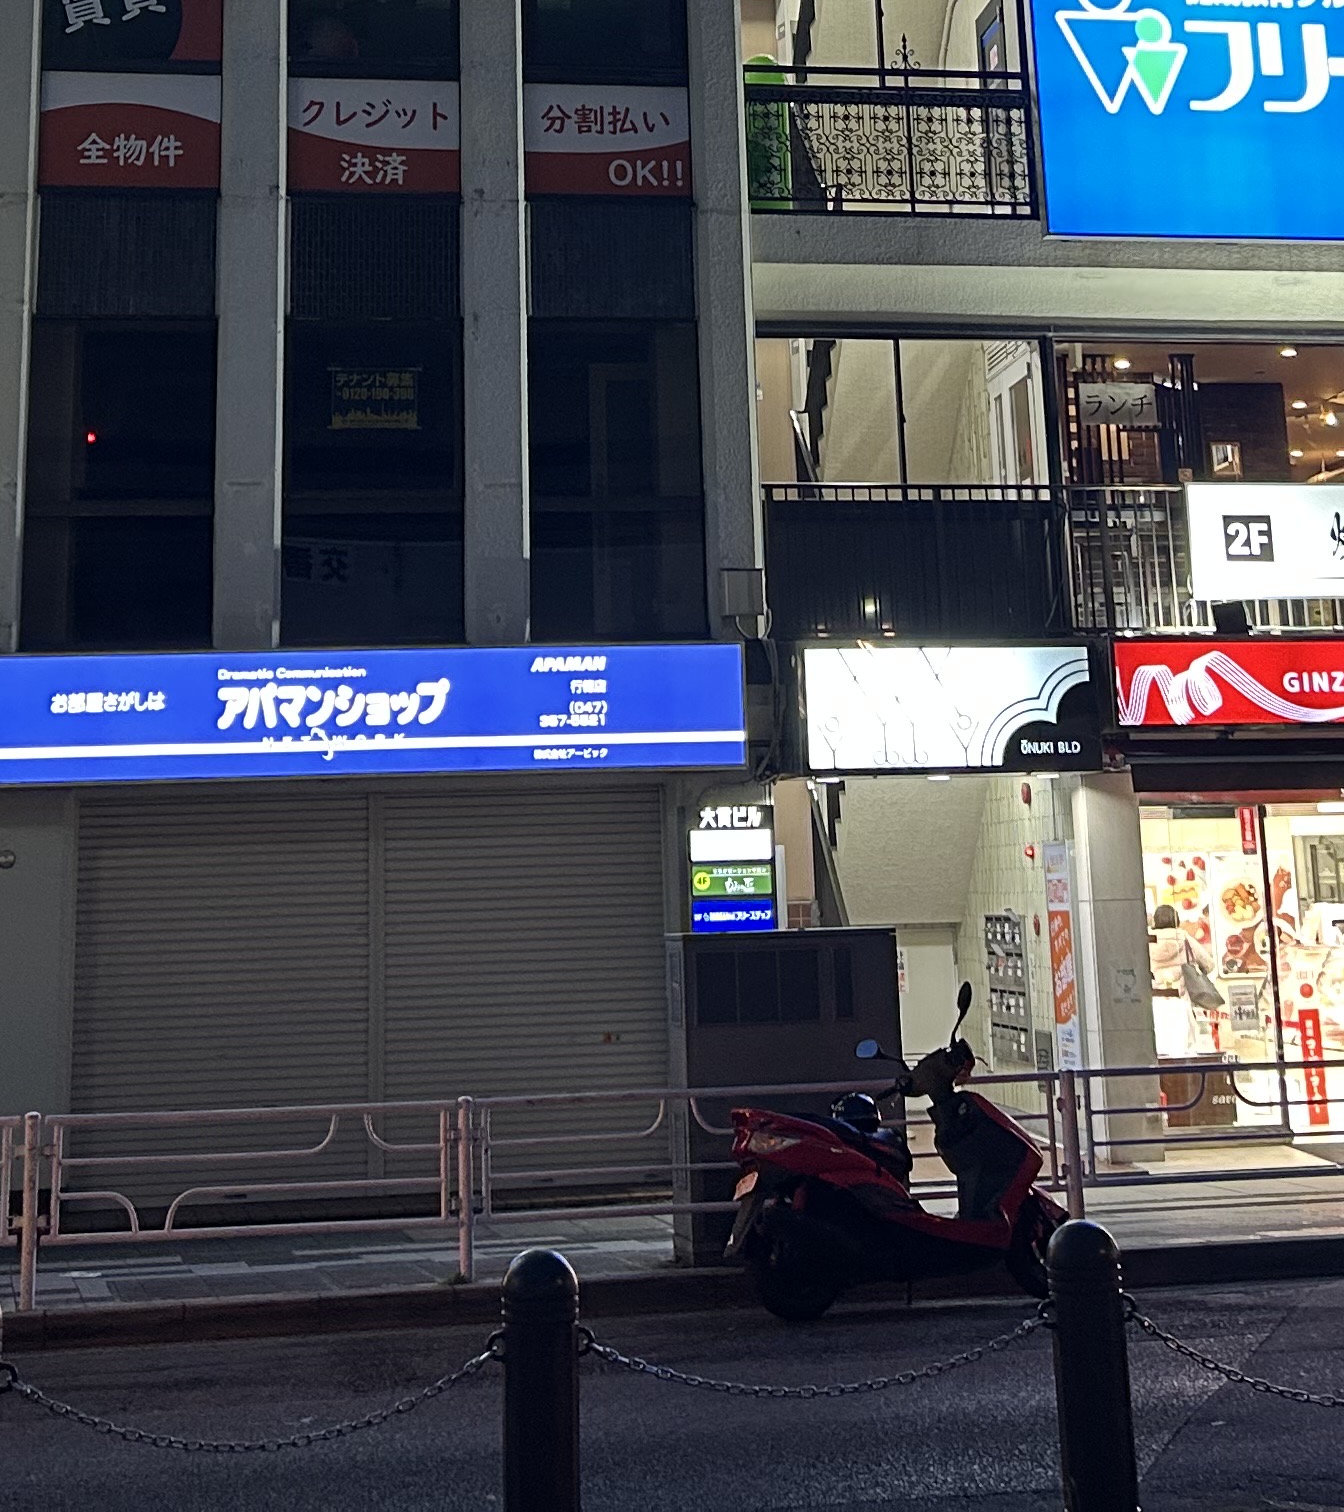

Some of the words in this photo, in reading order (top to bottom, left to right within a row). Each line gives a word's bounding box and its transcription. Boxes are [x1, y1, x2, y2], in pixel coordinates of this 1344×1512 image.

[301, 99, 450, 131] クレジット
[541, 103, 672, 137] 分割払い
[76, 132, 185, 169] 全物件
[339, 152, 410, 186] 決済
[608, 159, 684, 188] OK!!
[1085, 394, 1154, 418] ランチ
[1226, 521, 1271, 557] 2F
[217, 677, 451, 730] アパマンショップ
[1058, 740, 1082, 755] BLD
